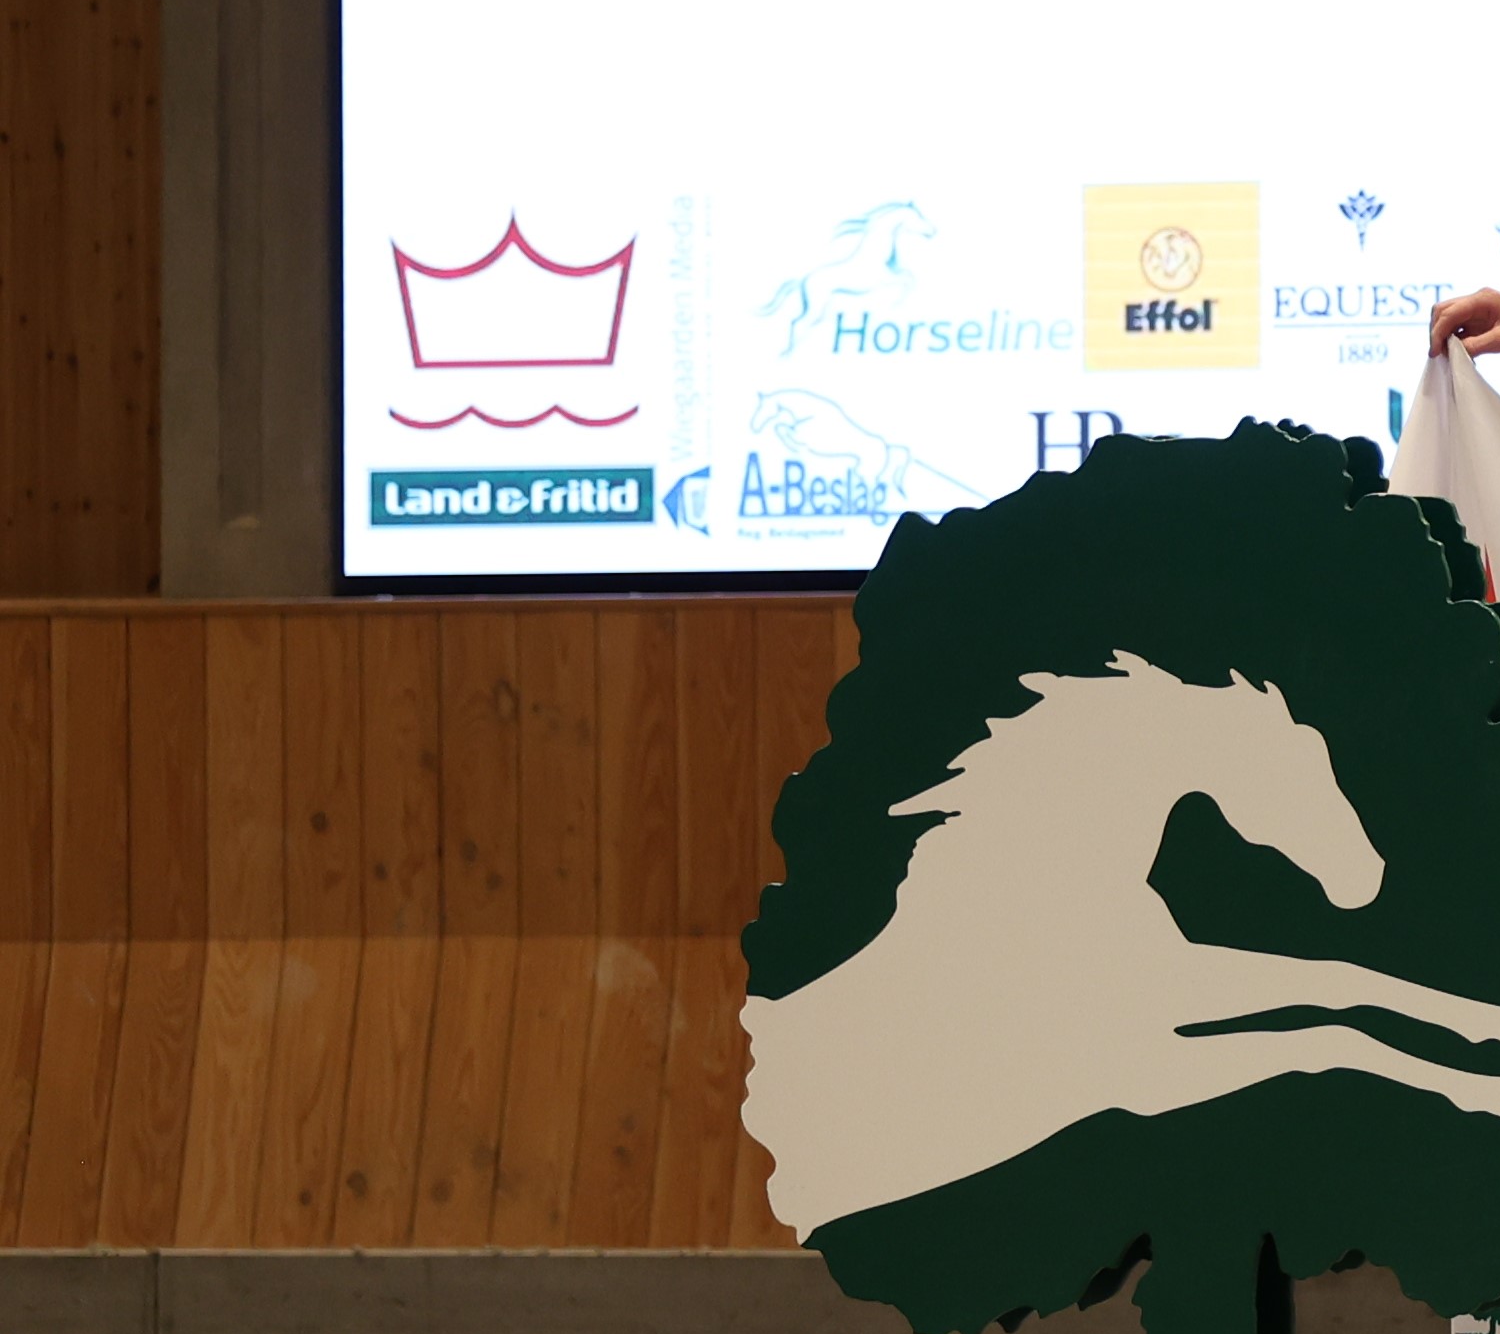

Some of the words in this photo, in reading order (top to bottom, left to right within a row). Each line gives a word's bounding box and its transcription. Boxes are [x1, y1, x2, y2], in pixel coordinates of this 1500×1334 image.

[1125, 299, 1214, 333] Effol
[1273, 282, 1453, 319] EQUEST
[831, 310, 1075, 357] Horseline
[1337, 343, 1391, 365] 1889
[384, 480, 492, 516] Land
[530, 478, 640, 514] Fritid
[739, 451, 889, 526] A-Beslag
